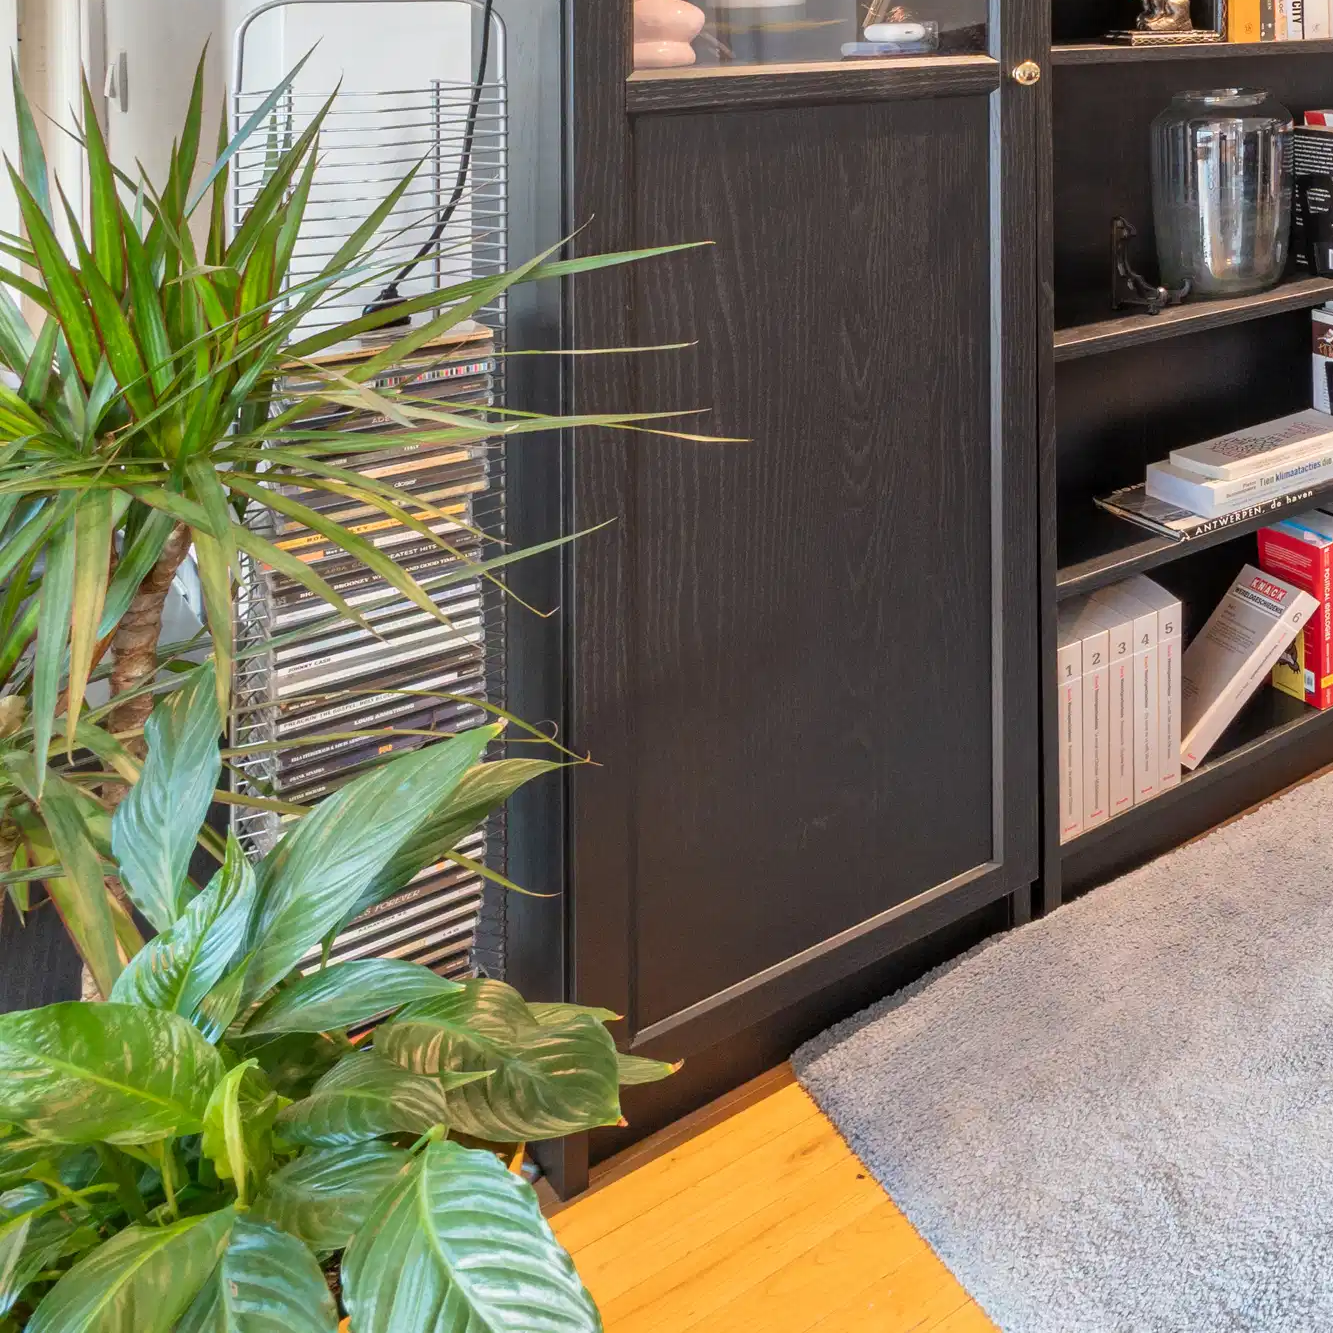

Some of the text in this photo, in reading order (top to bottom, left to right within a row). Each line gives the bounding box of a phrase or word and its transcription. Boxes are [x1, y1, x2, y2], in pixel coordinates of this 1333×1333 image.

[1291, 0, 1302, 25] CITY
[1259, 475, 1275, 488] Tien
[1275, 462, 1322, 483] klimaatacties
[1321, 457, 1333, 468] die
[1195, 490, 1314, 536] ANTWERPEN, de haven
[1250, 577, 1287, 601] KNACK
[1234, 586, 1284, 614] WERELDGESCHIEDENIS
[1292, 611, 1302, 623] 6
[1165, 621, 1174, 635] 5
[1141, 633, 1150, 645] 4
[1116, 641, 1127, 655] 3
[1092, 652, 1101, 666] 2
[1065, 665, 1073, 678] 1
